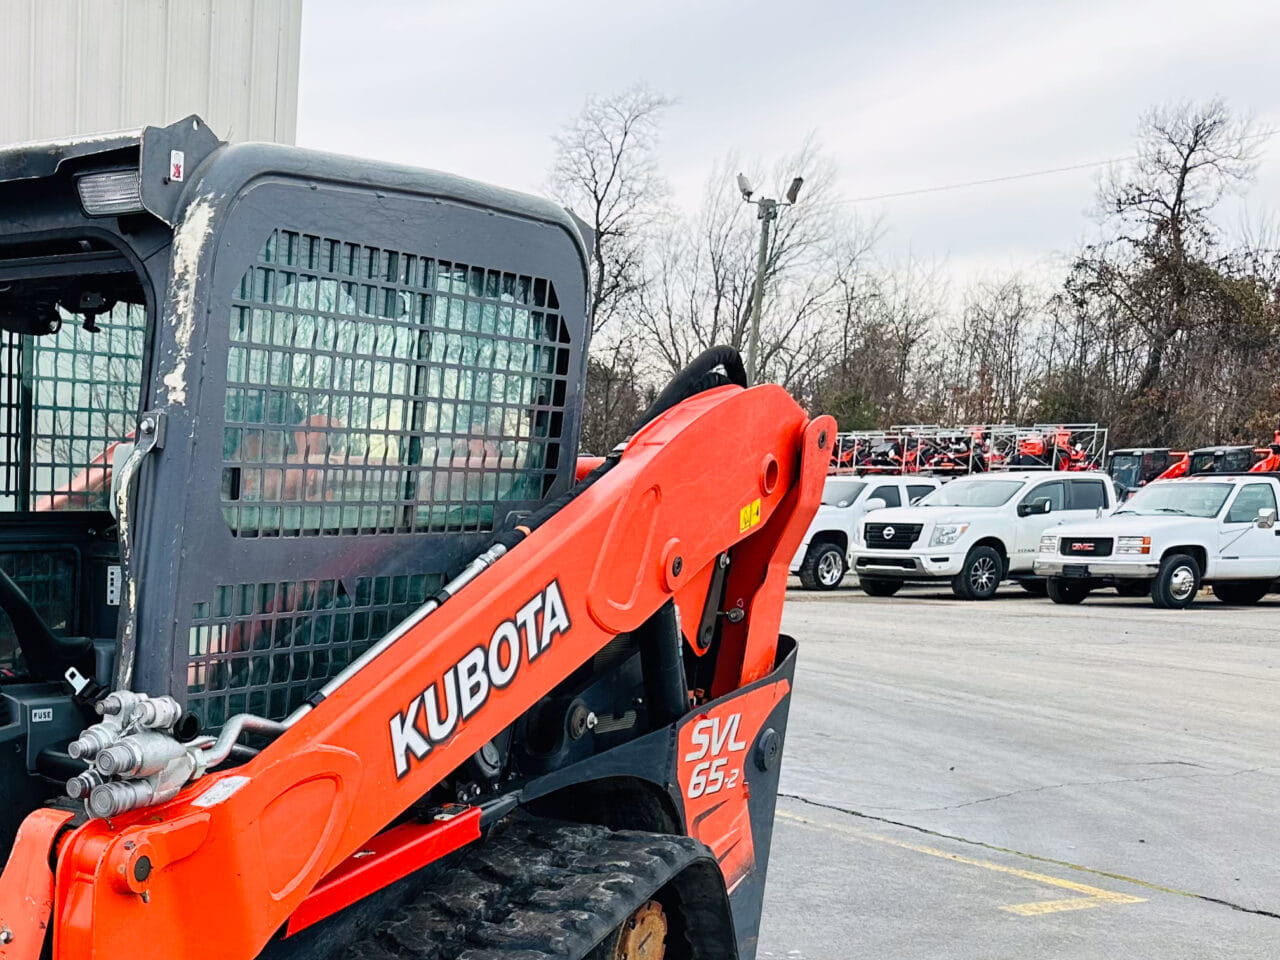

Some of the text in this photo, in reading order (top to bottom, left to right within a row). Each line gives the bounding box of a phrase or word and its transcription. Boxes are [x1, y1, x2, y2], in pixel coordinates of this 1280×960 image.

[1071, 543, 1095, 551] GMC
[390, 580, 570, 777] KUBOTA
[34, 711, 51, 720] FUSE
[685, 713, 747, 762] SVL
[687, 757, 740, 799] 65-2
